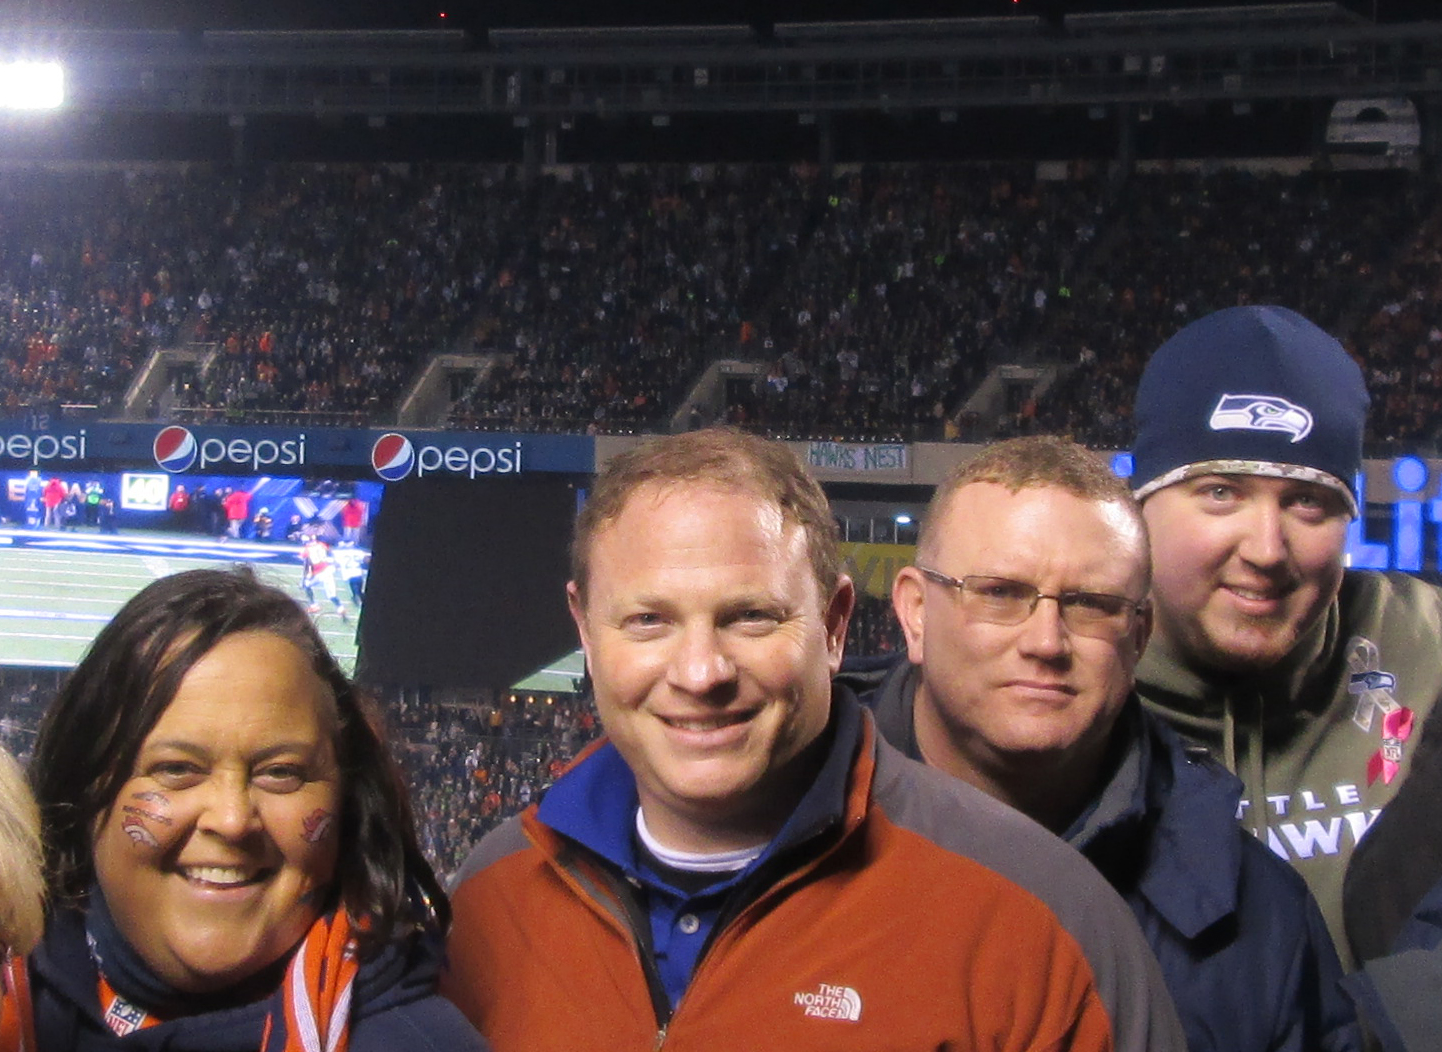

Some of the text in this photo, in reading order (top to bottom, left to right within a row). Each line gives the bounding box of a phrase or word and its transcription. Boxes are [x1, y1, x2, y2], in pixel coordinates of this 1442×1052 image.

[200, 434, 305, 470] pepsi
[418, 442, 522, 479] pepsi
[809, 441, 905, 469] HAWKS NEST
[794, 992, 842, 1008] NORTH
[819, 983, 844, 998] THE
[804, 1005, 837, 1018] FACE
